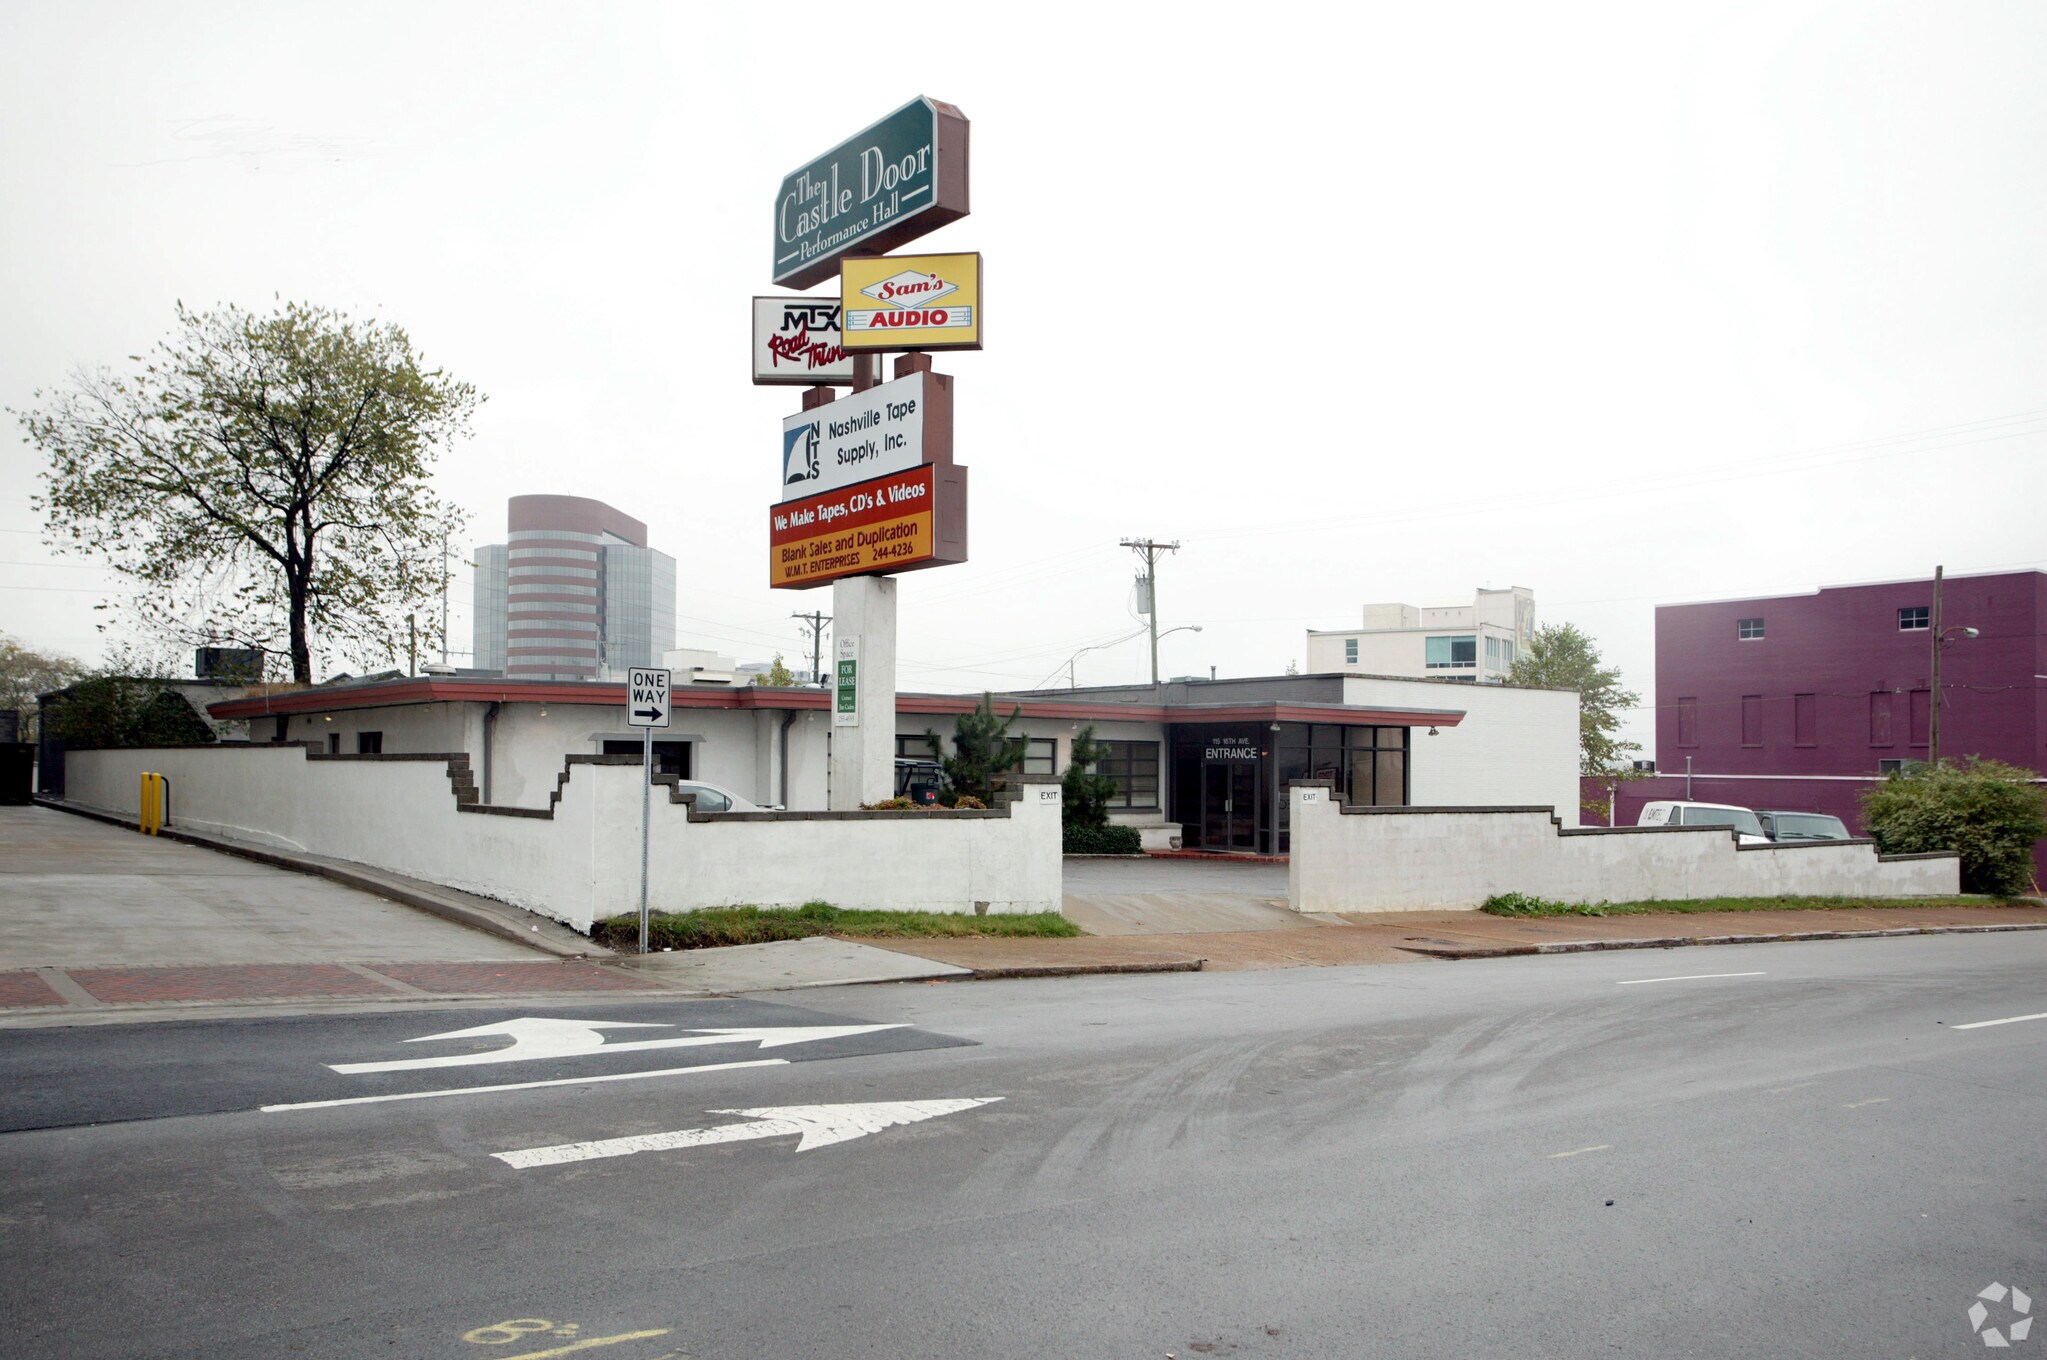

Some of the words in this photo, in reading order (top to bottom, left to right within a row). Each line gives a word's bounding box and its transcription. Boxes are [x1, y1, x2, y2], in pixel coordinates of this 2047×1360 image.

[779, 162, 853, 244] Castle
[860, 143, 931, 204] Door
[796, 172, 821, 205] The
[800, 219, 868, 260] Performance
[873, 191, 899, 225] Hall
[878, 273, 943, 300] Sam's
[780, 304, 840, 331] MTX
[869, 309, 948, 327] AUDIO
[768, 321, 810, 367] Road
[829, 409, 880, 440] Nashville
[886, 399, 916, 422] Tape
[837, 439, 879, 465] Supply,
[885, 432, 907, 452] Inc.
[774, 515, 787, 531] We
[790, 508, 815, 528] Make
[817, 501, 848, 522] Tapes,
[849, 493, 873, 513] CD's
[876, 490, 886, 507] &
[888, 481, 926, 503] Videos
[782, 546, 807, 563] Blank
[810, 540, 832, 557] Sales
[835, 535, 854, 551] and
[857, 521, 917, 548] Duplication
[785, 561, 808, 578] W.M.T.
[810, 552, 860, 573] ENTERPRISES
[872, 542, 913, 561] 244-4236
[634, 672, 665, 687] ONE
[839, 676, 855, 686] LEASE
[841, 664, 853, 674] FOR
[633, 689, 666, 704] WAY
[1205, 747, 1257, 759] ENTRANCE
[1040, 791, 1058, 800] EXIT
[1303, 793, 1316, 801] EXIT
